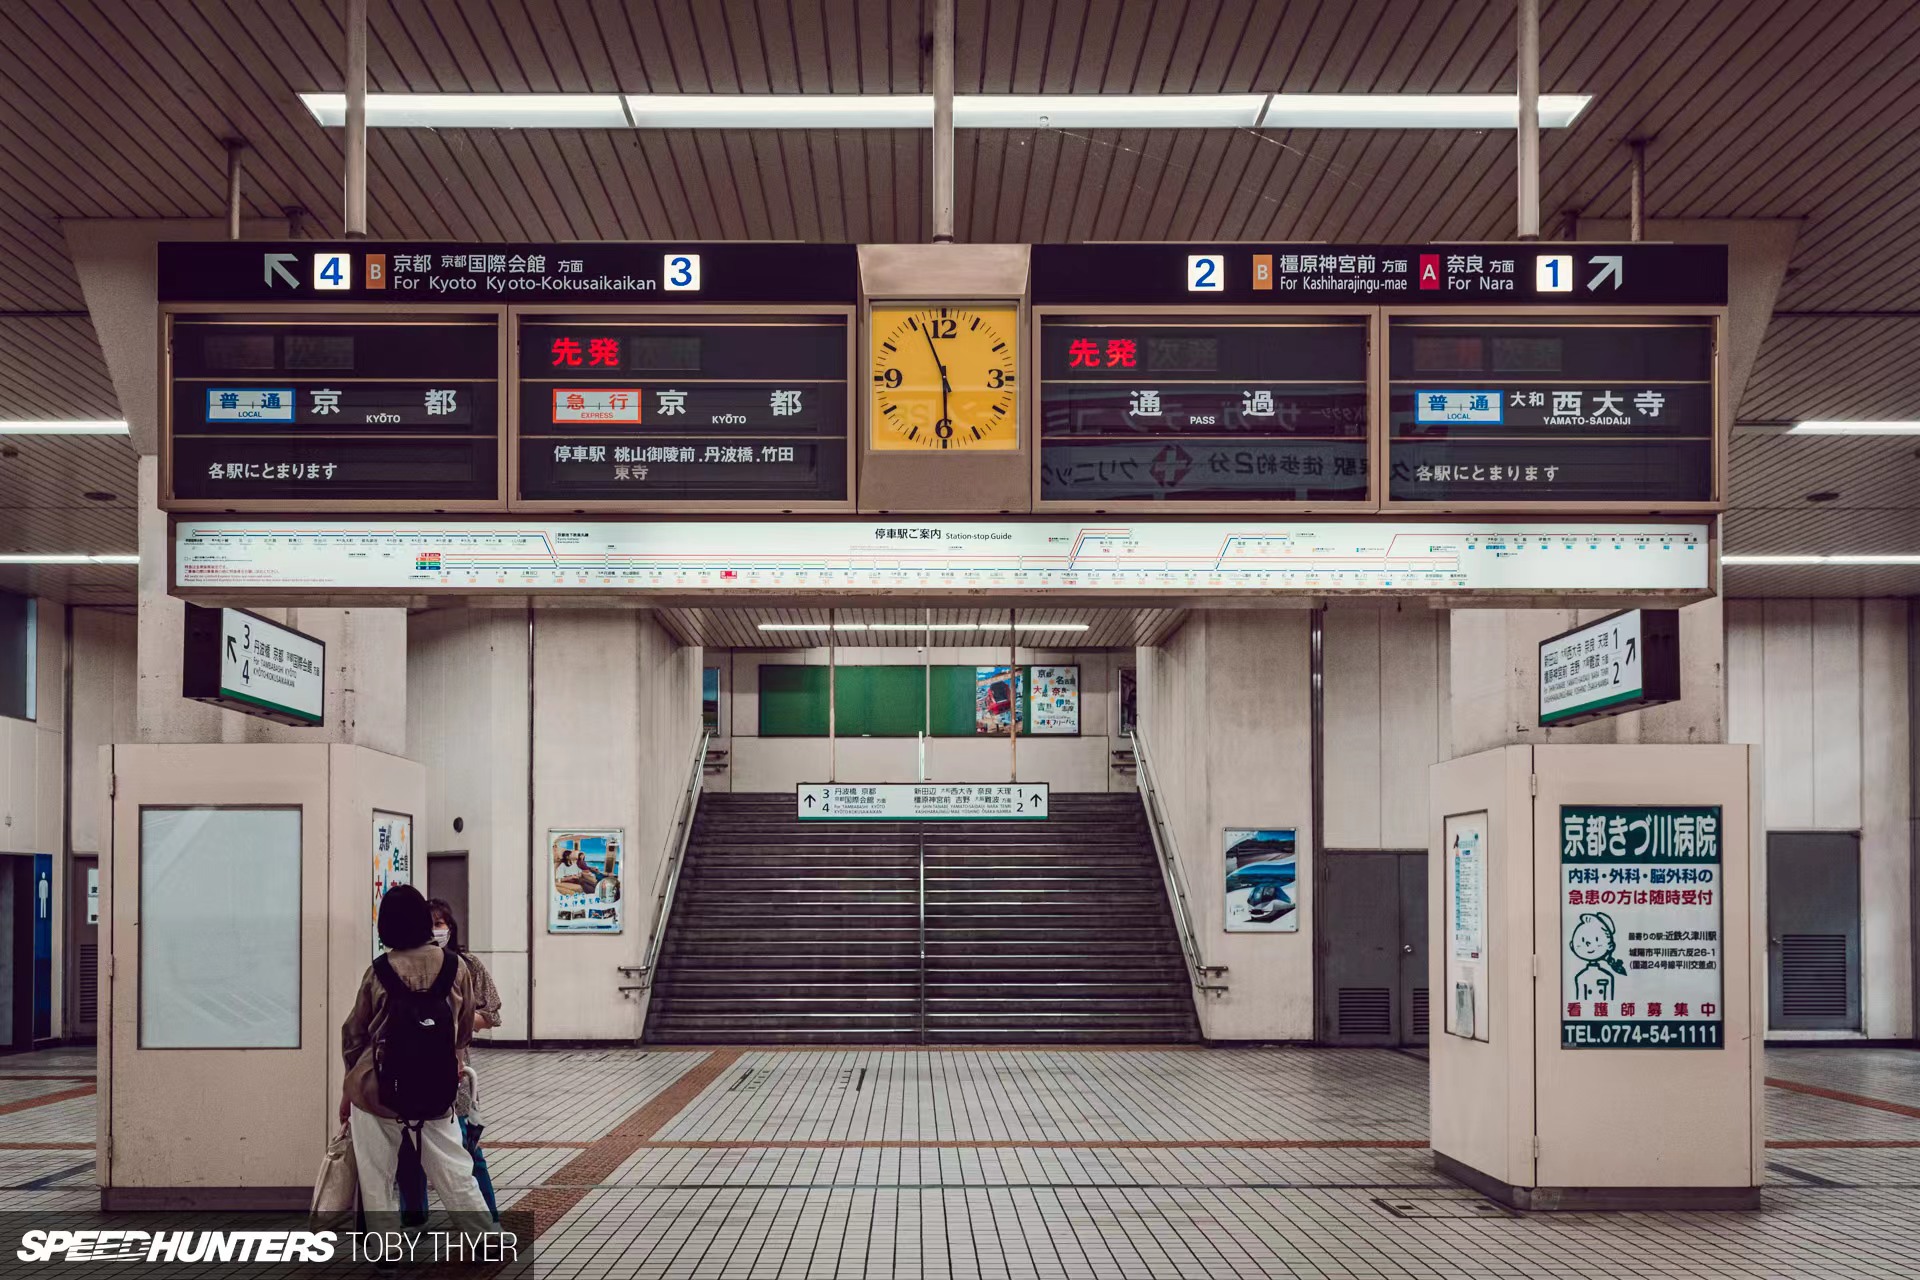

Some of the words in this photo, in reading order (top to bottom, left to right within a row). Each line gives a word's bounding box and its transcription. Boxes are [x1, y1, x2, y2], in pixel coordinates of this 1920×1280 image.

[320, 257, 343, 286] 4
[370, 264, 381, 280] B
[393, 254, 432, 273] 京都
[441, 254, 546, 273] 京都国際会館
[557, 260, 584, 273] 方面
[670, 257, 692, 287] 3
[1195, 258, 1216, 287] 2
[1257, 264, 1268, 280] B
[1280, 254, 1376, 273] 橿原神宮前
[1382, 260, 1408, 273] 方面
[1422, 264, 1437, 281] A
[1447, 254, 1484, 274] 奈良
[1489, 260, 1515, 273] 方面
[1545, 258, 1559, 287] 1
[393, 276, 420, 290] For
[429, 276, 477, 293] Kyoto
[1280, 276, 1298, 290] For
[1303, 276, 1408, 294] Kashiharajingu-mae
[1448, 276, 1471, 290] For
[1480, 276, 1514, 290] Nara
[931, 319, 957, 339] 12
[551, 336, 619, 367] 先発
[1068, 337, 1137, 368] 先発
[884, 368, 903, 389] 9
[987, 368, 1005, 389] 3
[219, 392, 281, 410] 普通
[310, 388, 457, 416] 京都
[566, 393, 629, 411] 急行
[656, 389, 802, 416] 京都
[1129, 390, 1275, 417] 通過
[1427, 394, 1490, 411] 普通
[1510, 391, 1545, 408] 大和
[1552, 390, 1666, 417] 西大寺
[366, 413, 401, 424] KYŌTO
[712, 413, 747, 424] KYŌTO
[1190, 416, 1216, 425] PASS
[1446, 412, 1471, 420] LOCAL
[1543, 416, 1631, 425] YAMATO-SAIDAIJI
[935, 418, 953, 439] 6
[553, 445, 606, 463] 停車駅
[208, 462, 337, 480] 各駅にとまります
[614, 464, 649, 481] 東寺
[1416, 464, 1559, 481] 各駅にとまります
[875, 528, 941, 539] 停車駅ご案内
[945, 532, 989, 541] Station-stop
[990, 532, 1012, 540] Guide
[243, 624, 250, 650] 3
[1613, 627, 1618, 650] 1
[242, 659, 250, 685] 4
[1613, 661, 1620, 685] 2
[822, 788, 830, 799] 3
[861, 787, 877, 795] 京都
[997, 787, 1012, 795] 天理
[1016, 788, 1022, 798] 1
[822, 803, 830, 813] 4
[1016, 802, 1024, 813] 2
[1564, 814, 1717, 857] 京都きづ川病院
[1568, 889, 1713, 905] 急患の方は随時受付
[1629, 947, 1716, 957] 城陽市平川西六反26-1
[1567, 1002, 1716, 1017] 看護師募集中
[1565, 1024, 1716, 1044] TEL.0774-54-1111
